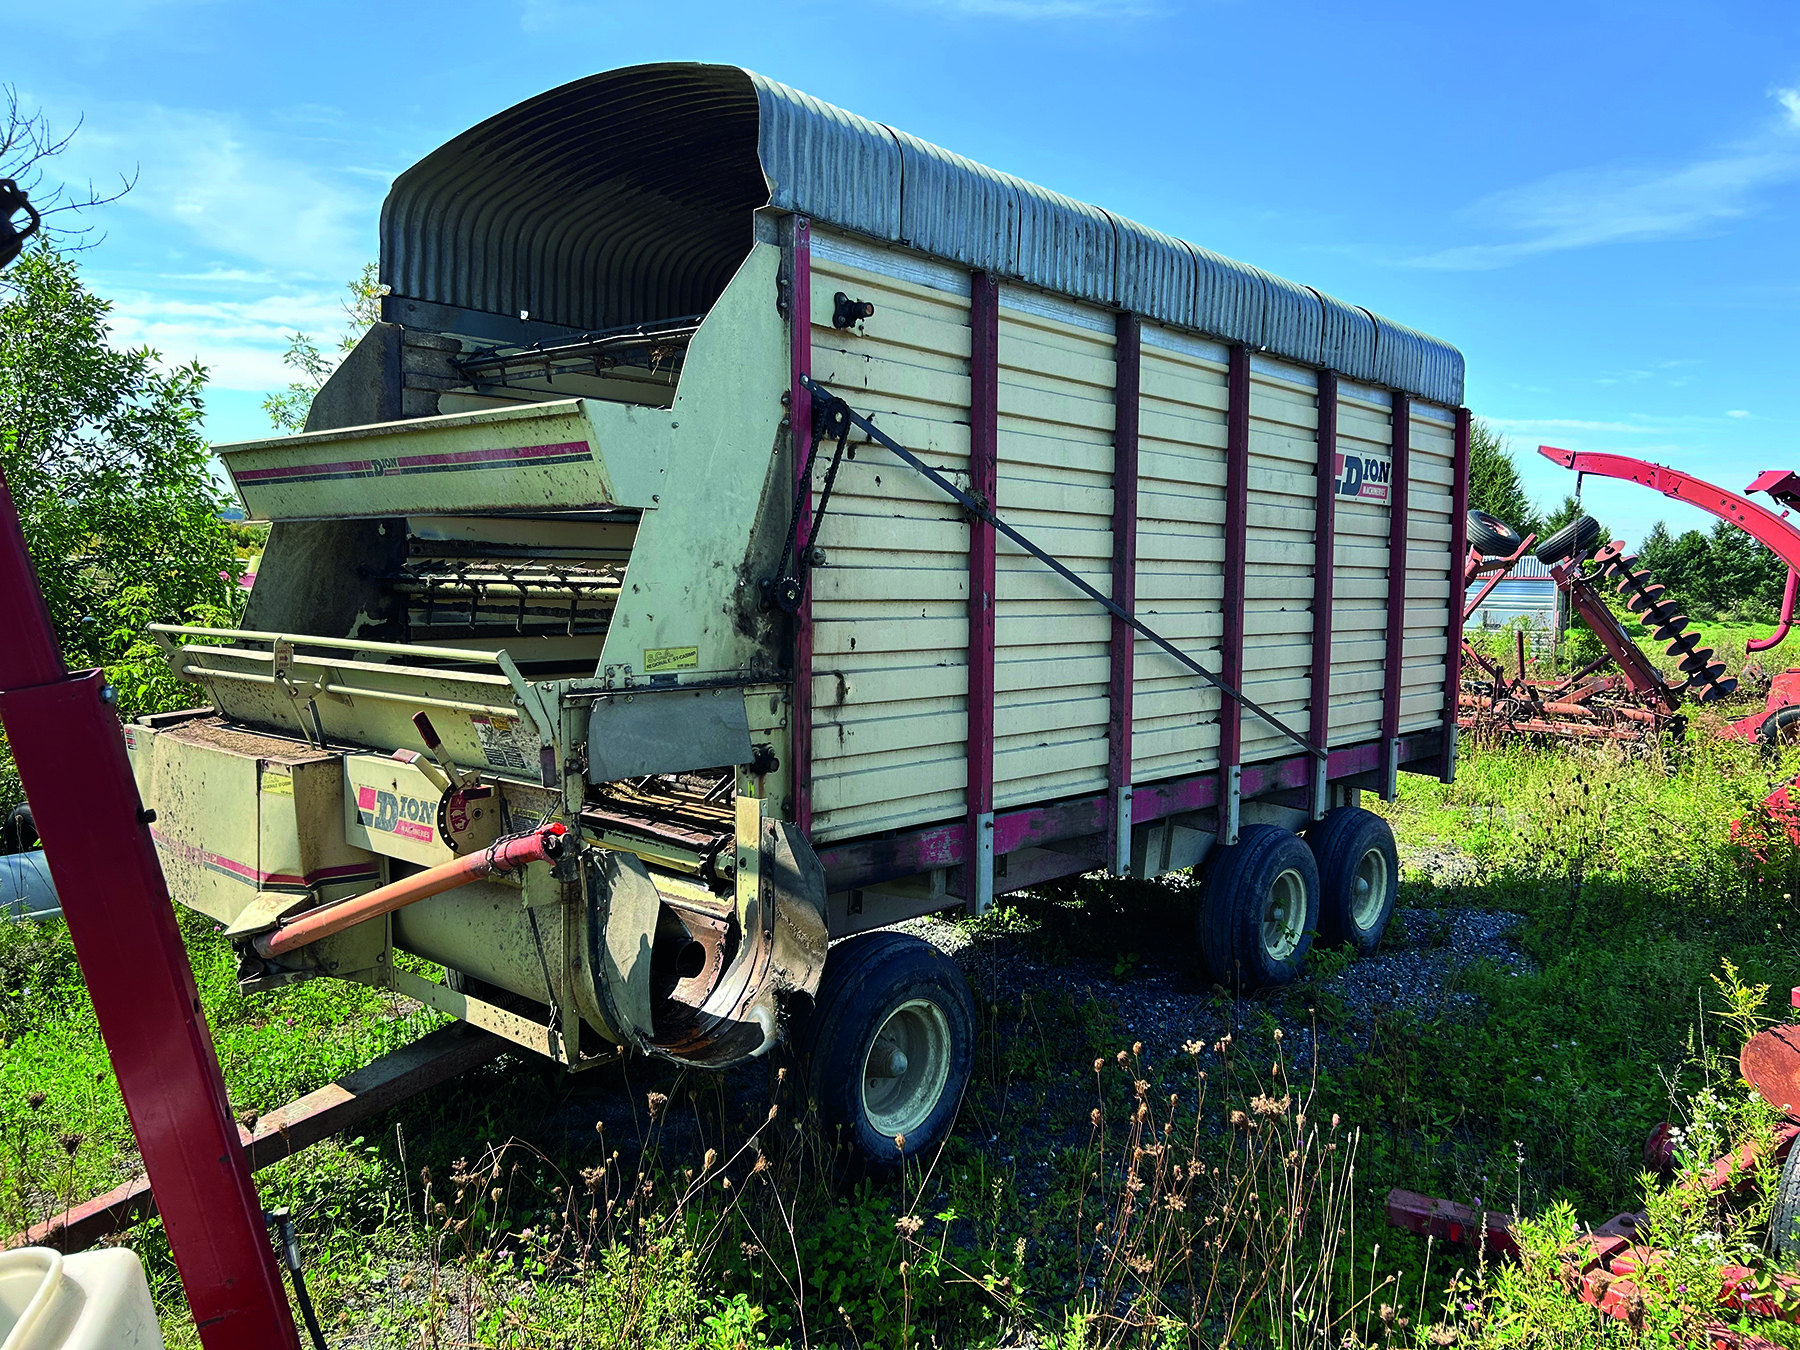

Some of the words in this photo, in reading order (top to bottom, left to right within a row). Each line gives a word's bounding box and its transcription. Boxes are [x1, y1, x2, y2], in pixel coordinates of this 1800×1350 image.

[370, 457, 398, 477] DION
[1340, 454, 1391, 496] DION
[374, 790, 437, 832] DION
